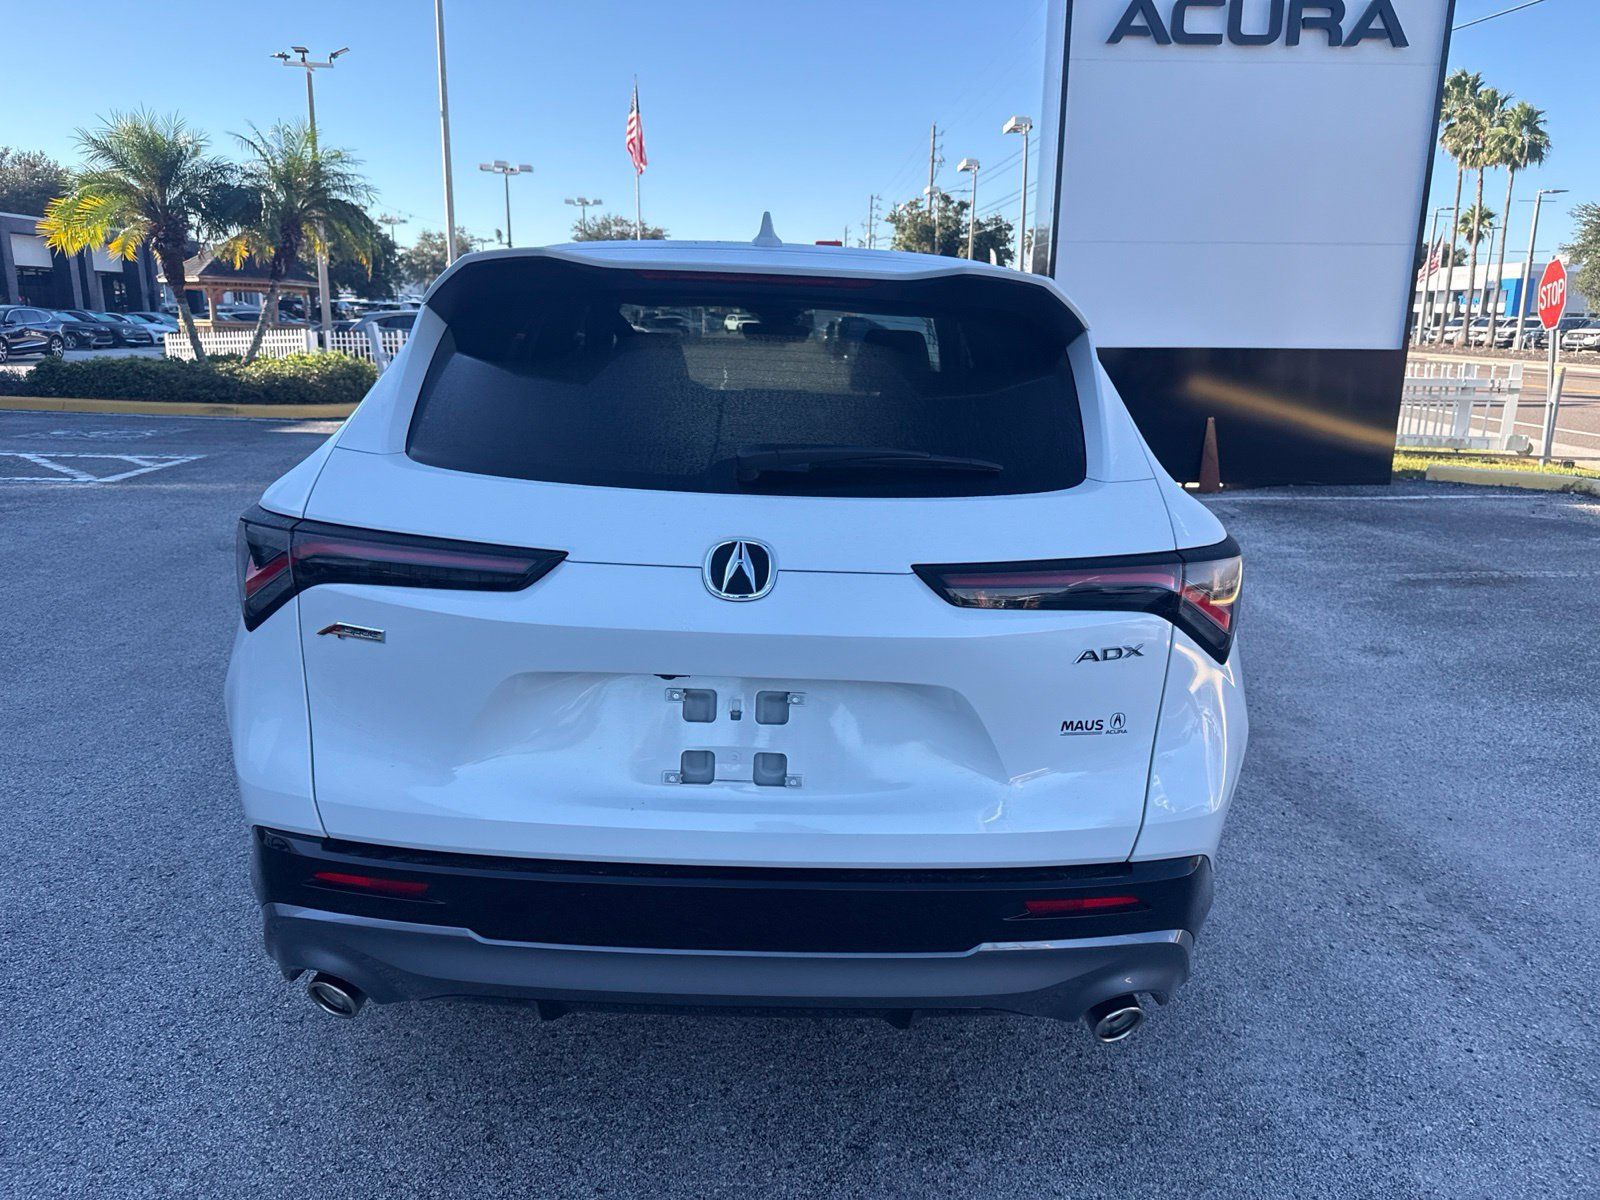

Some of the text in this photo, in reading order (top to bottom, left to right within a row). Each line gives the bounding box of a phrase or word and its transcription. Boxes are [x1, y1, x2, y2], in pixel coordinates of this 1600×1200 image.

[1105, 0, 1409, 47] ACURA
[1541, 279, 1565, 311] STOP
[1072, 643, 1144, 664] ADX
[1060, 719, 1104, 732] MAUS
